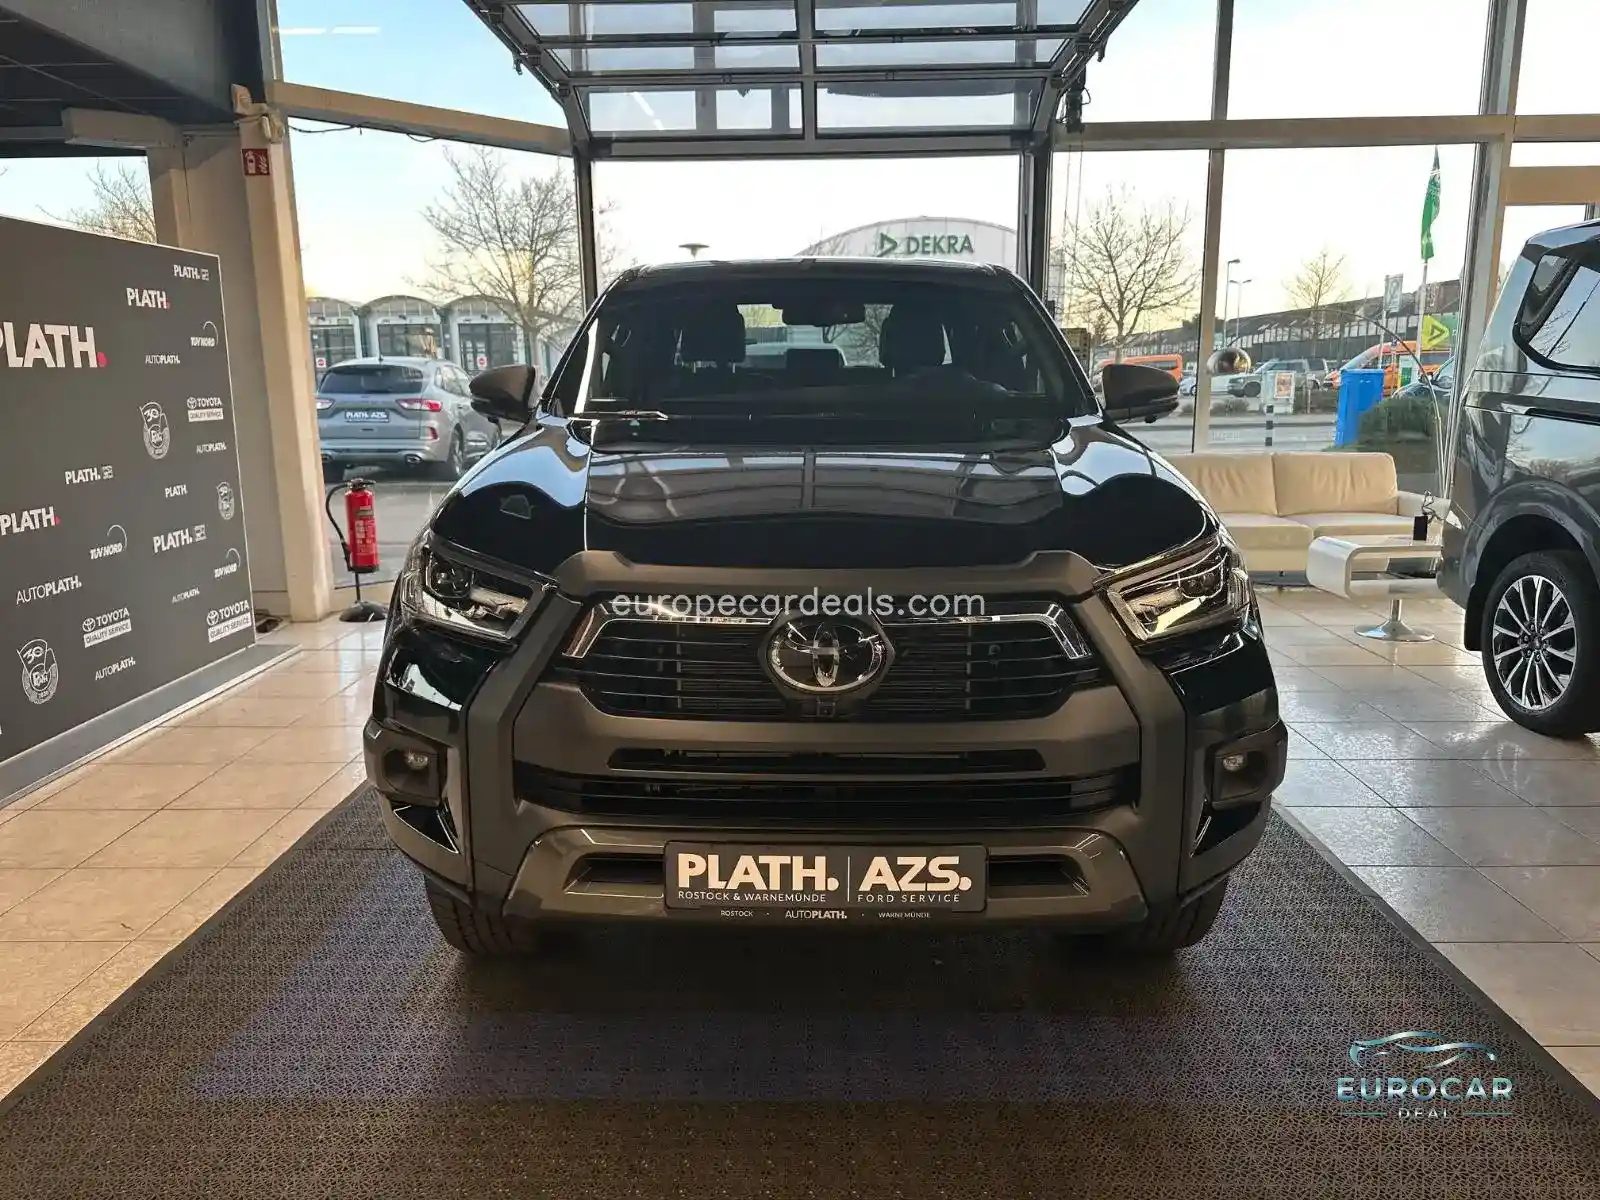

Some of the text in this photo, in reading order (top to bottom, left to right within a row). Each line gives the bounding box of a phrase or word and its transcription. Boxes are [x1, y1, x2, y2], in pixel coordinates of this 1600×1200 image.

[907, 234, 974, 255] DEKRA
[173, 264, 200, 280] PLATH.
[126, 287, 171, 309] PLATH.
[196, 397, 222, 407] TOYOTA
[64, 467, 101, 485] PLATH.
[0, 506, 60, 536] PLATH.
[103, 542, 123, 557] NORD
[152, 527, 193, 554] PLATH.
[16, 575, 82, 605] AUTOPLATH.
[96, 607, 130, 627] TOYOTA
[219, 600, 250, 620] TOYOTA
[23, 646, 44, 664] 30
[95, 656, 136, 681] AUTOPLATH.
[677, 853, 840, 892] PLATH.
[858, 855, 972, 892] AZS.
[678, 890, 827, 903] ROSTOCK & WARNEMÜNDE
[857, 894, 960, 903] FORD SERVICE
[720, 909, 754, 917] ROSTOCK
[785, 909, 848, 920] AUTOPLATH.
